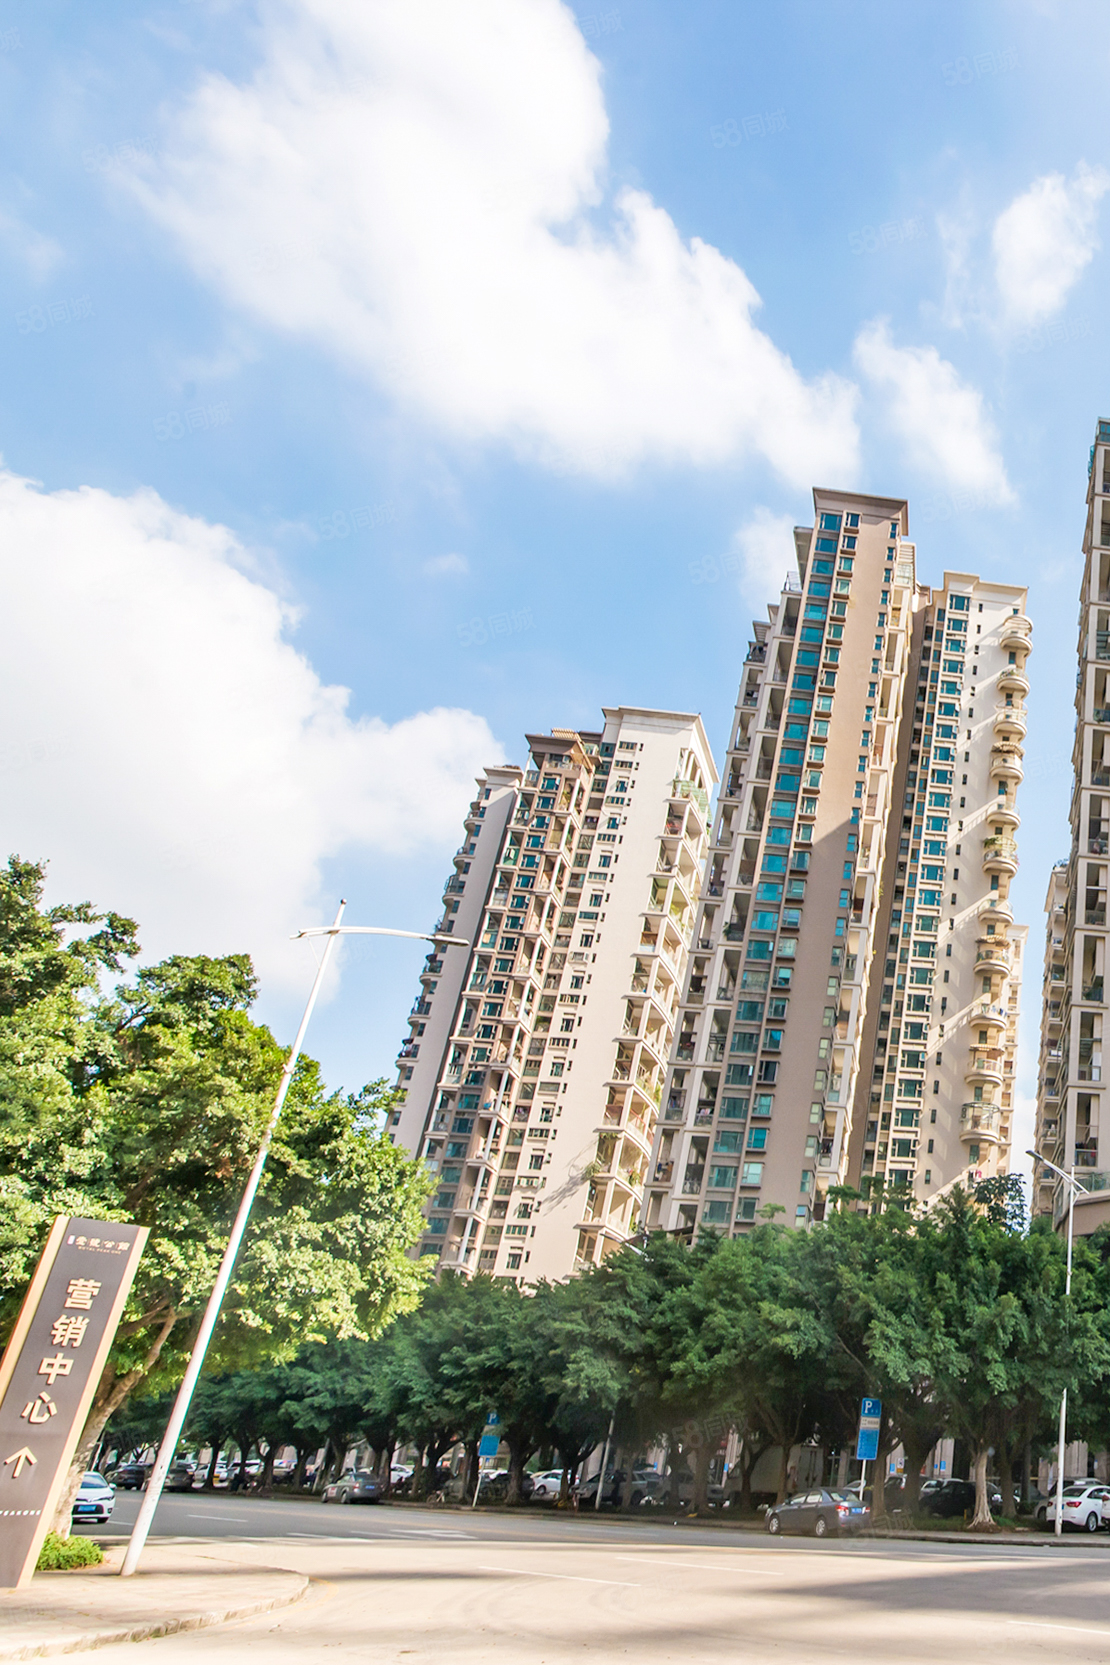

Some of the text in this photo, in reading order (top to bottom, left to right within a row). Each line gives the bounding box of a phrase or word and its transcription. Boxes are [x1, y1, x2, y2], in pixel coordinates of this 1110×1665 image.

[20, 1278, 102, 1424] 营销中心
[865, 1401, 872, 1413] P
